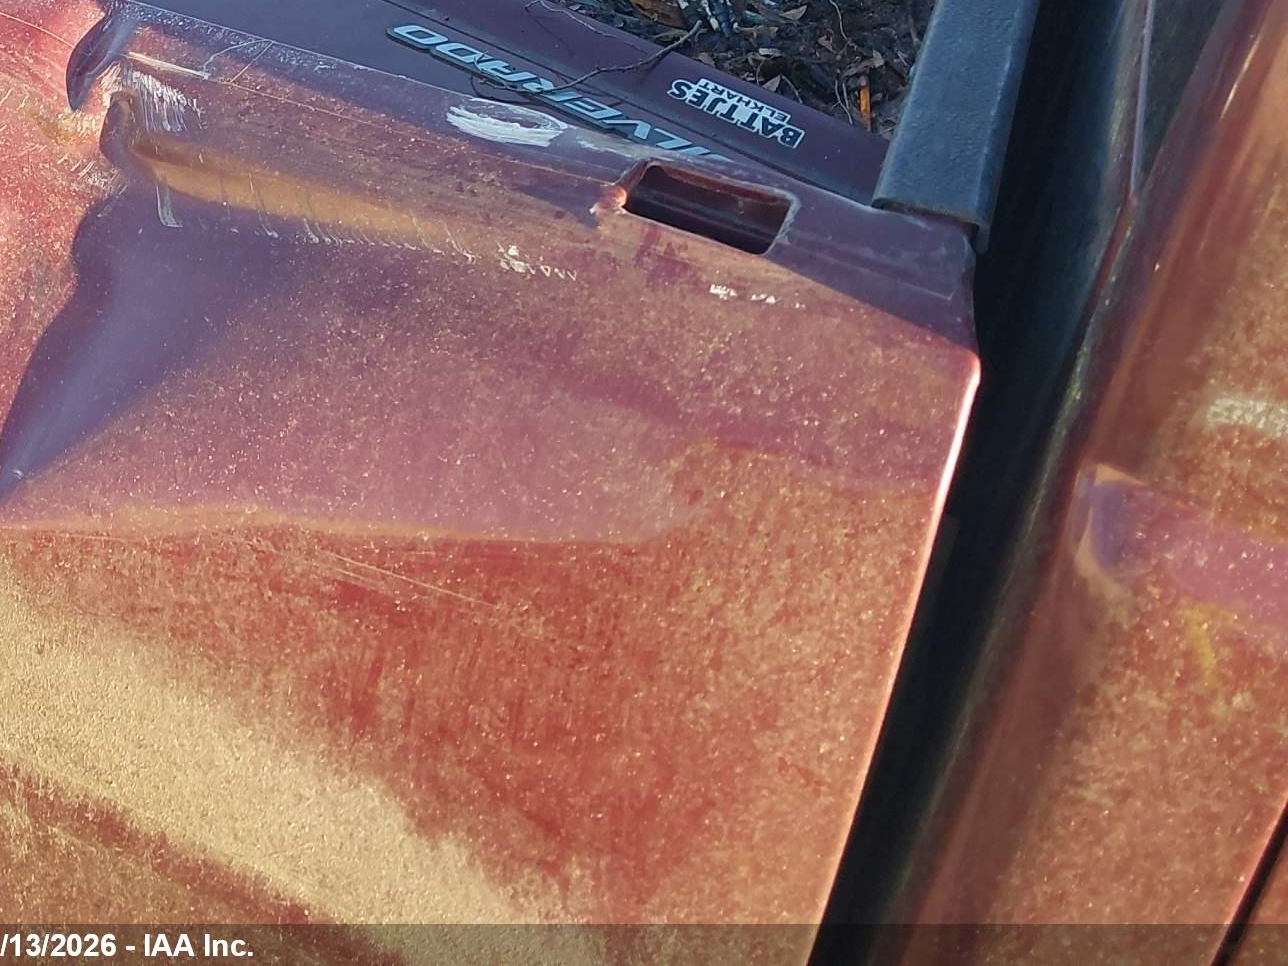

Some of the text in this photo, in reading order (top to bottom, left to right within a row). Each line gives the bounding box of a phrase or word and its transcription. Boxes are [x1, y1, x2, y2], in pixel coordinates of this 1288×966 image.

[389, 24, 734, 163] ILVERADO
[667, 80, 804, 148] BATTJES
[698, 80, 788, 122] ELKHART
